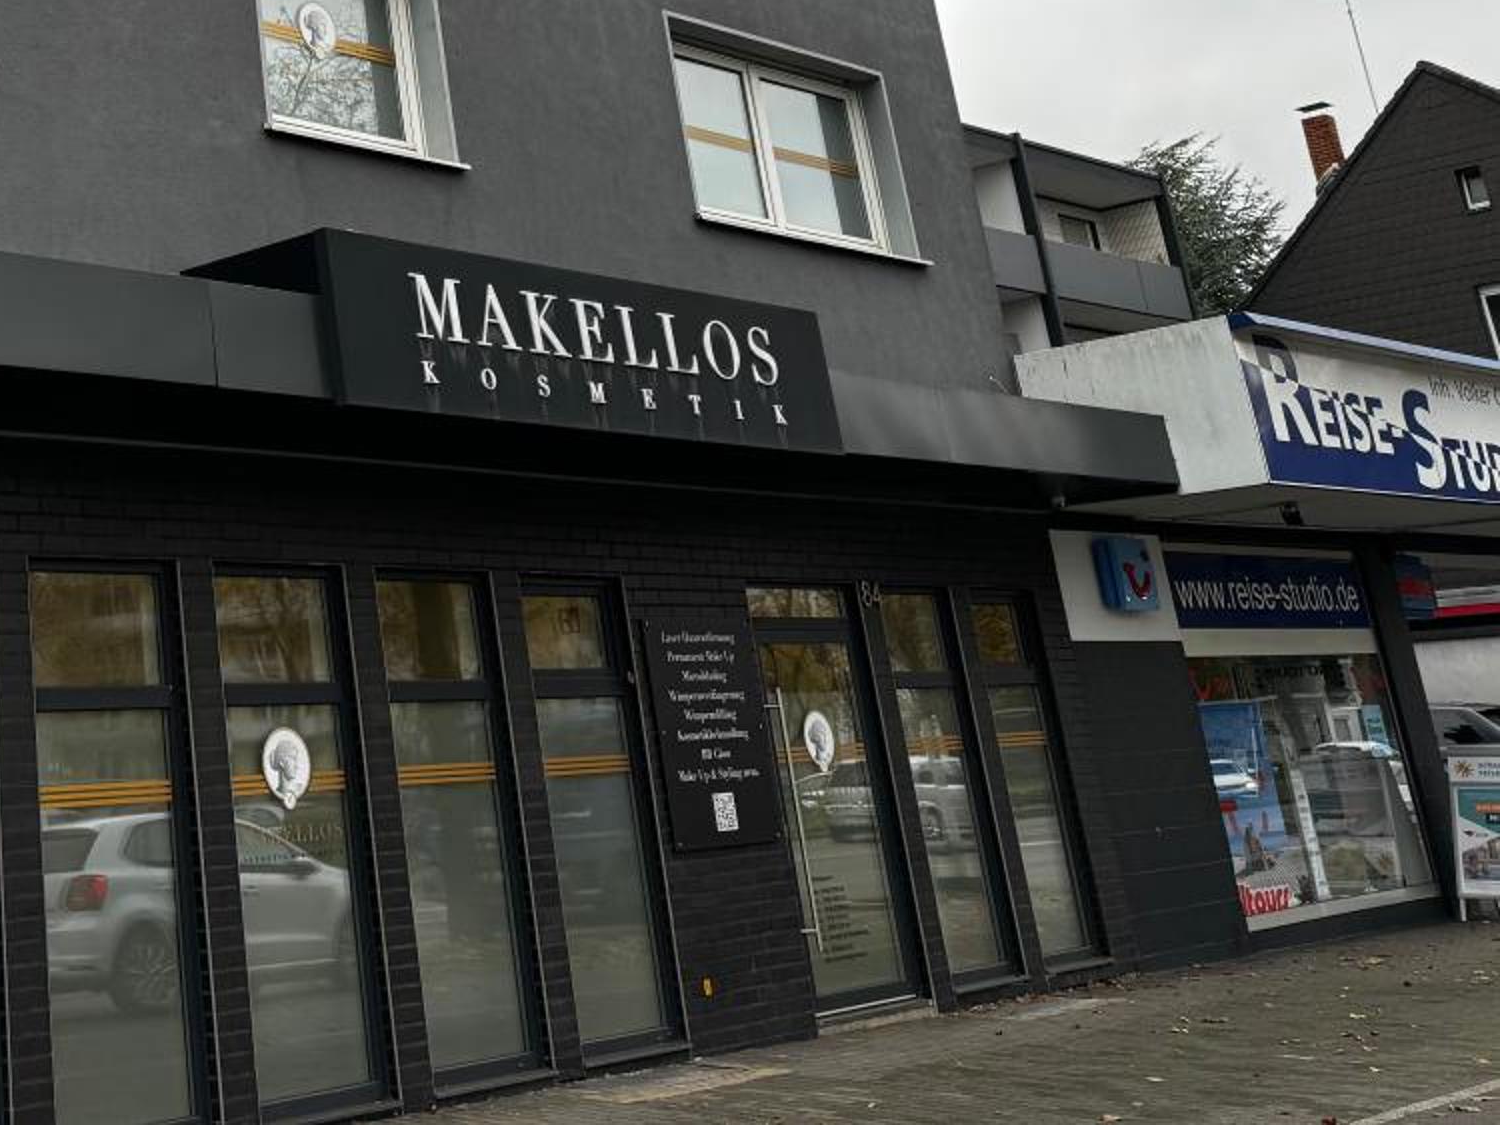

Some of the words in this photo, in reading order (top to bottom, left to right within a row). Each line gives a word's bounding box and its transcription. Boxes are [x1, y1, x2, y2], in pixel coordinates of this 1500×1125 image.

[408, 272, 780, 386] MAKELLOS
[421, 360, 788, 425] KOSMETIK
[1175, 577, 1360, 612] www.reise-studio.de
